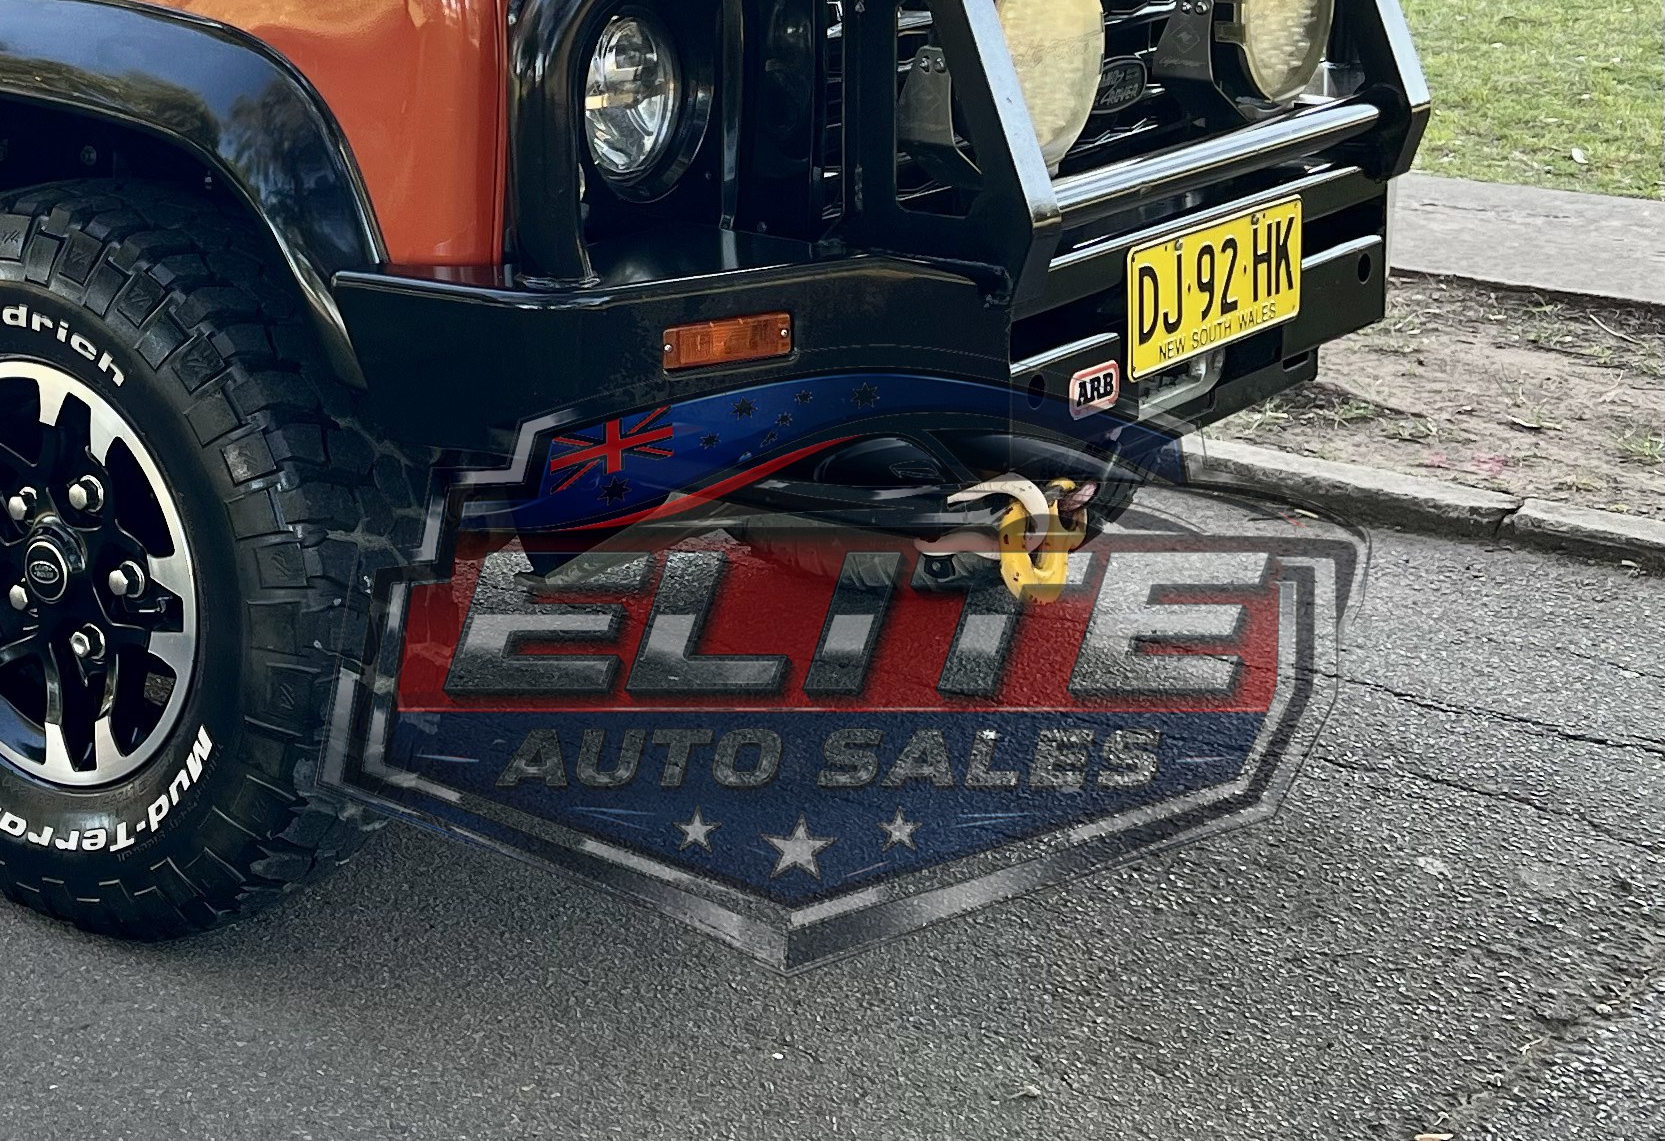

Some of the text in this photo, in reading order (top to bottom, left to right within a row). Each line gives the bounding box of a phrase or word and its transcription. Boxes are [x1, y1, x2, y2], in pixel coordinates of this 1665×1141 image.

[1159, 301, 1276, 361] NEW SOUTH WALES
[1075, 372, 1114, 407] ARB
